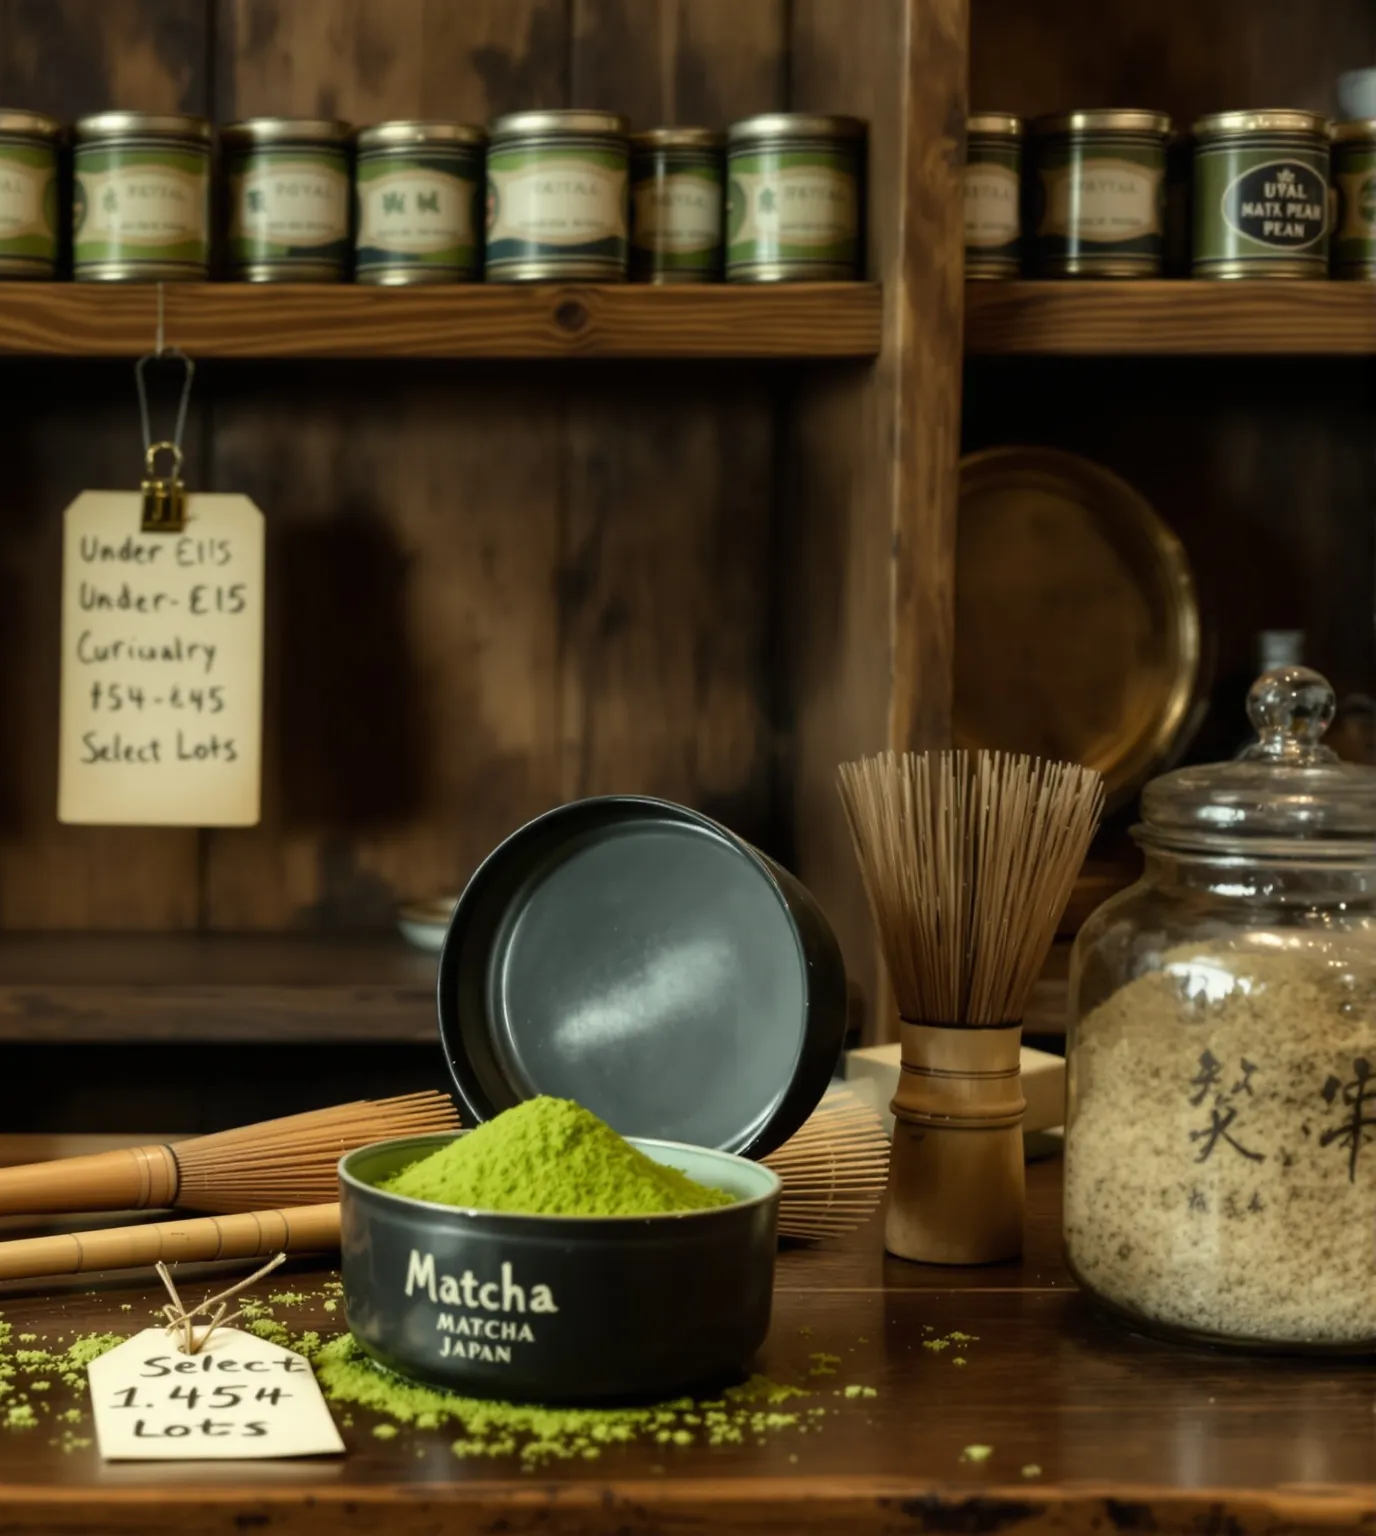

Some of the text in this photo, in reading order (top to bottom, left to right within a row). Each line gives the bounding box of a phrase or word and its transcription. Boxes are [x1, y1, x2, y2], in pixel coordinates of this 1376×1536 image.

[79, 535, 164, 565] Under
[81, 728, 239, 764] Select Lots
[405, 1249, 559, 1314] Matcha
[436, 1311, 536, 1343] MATCHA
[439, 1335, 512, 1365] JAPAN
[139, 1354, 307, 1378] Select
[132, 1417, 270, 1438] Lots
